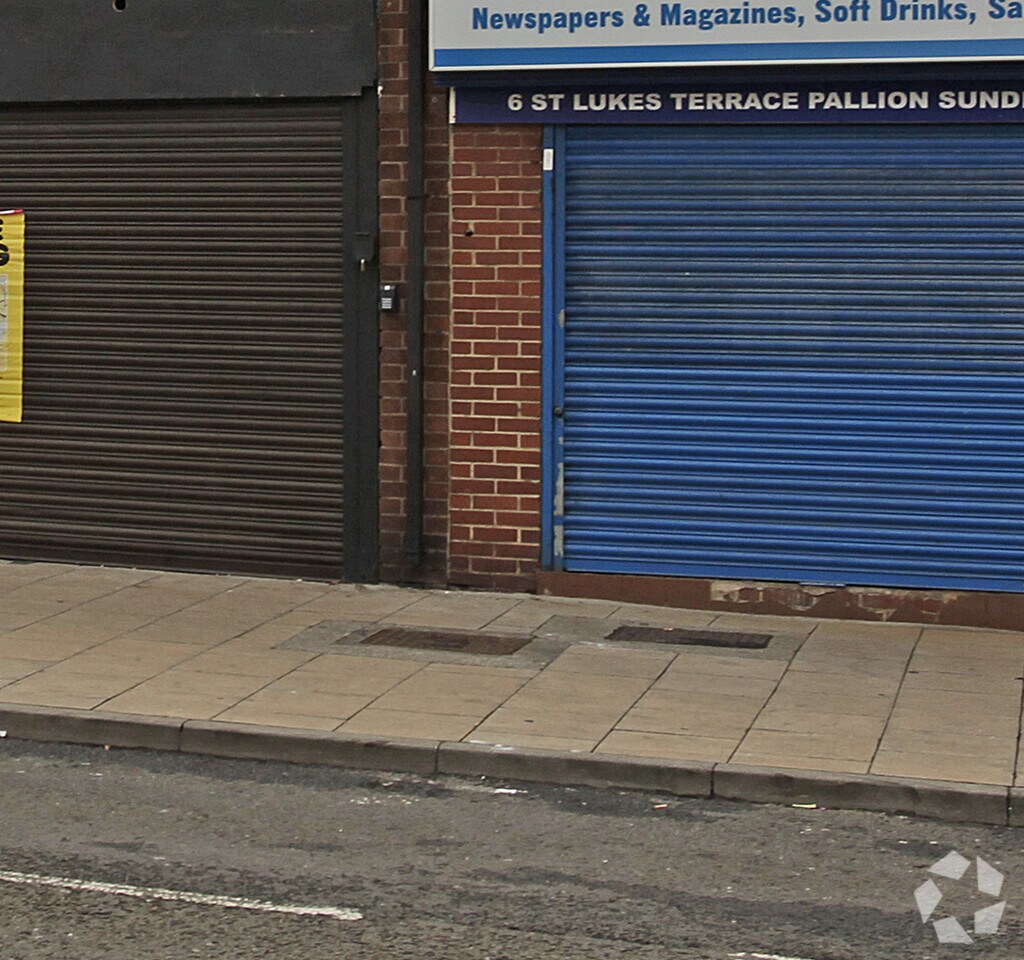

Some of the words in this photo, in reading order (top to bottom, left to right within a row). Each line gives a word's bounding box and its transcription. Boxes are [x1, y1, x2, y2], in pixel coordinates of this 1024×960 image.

[472, 7, 624, 34] Newspapers
[633, 3, 651, 27] &
[660, 1, 805, 31] Magazines,
[507, 94, 524, 111] 6
[531, 94, 565, 111] ST
[573, 93, 662, 111] LUKES
[670, 92, 799, 111] TERRACE
[808, 92, 929, 110] PALLION
[938, 91, 1024, 110] SUND
